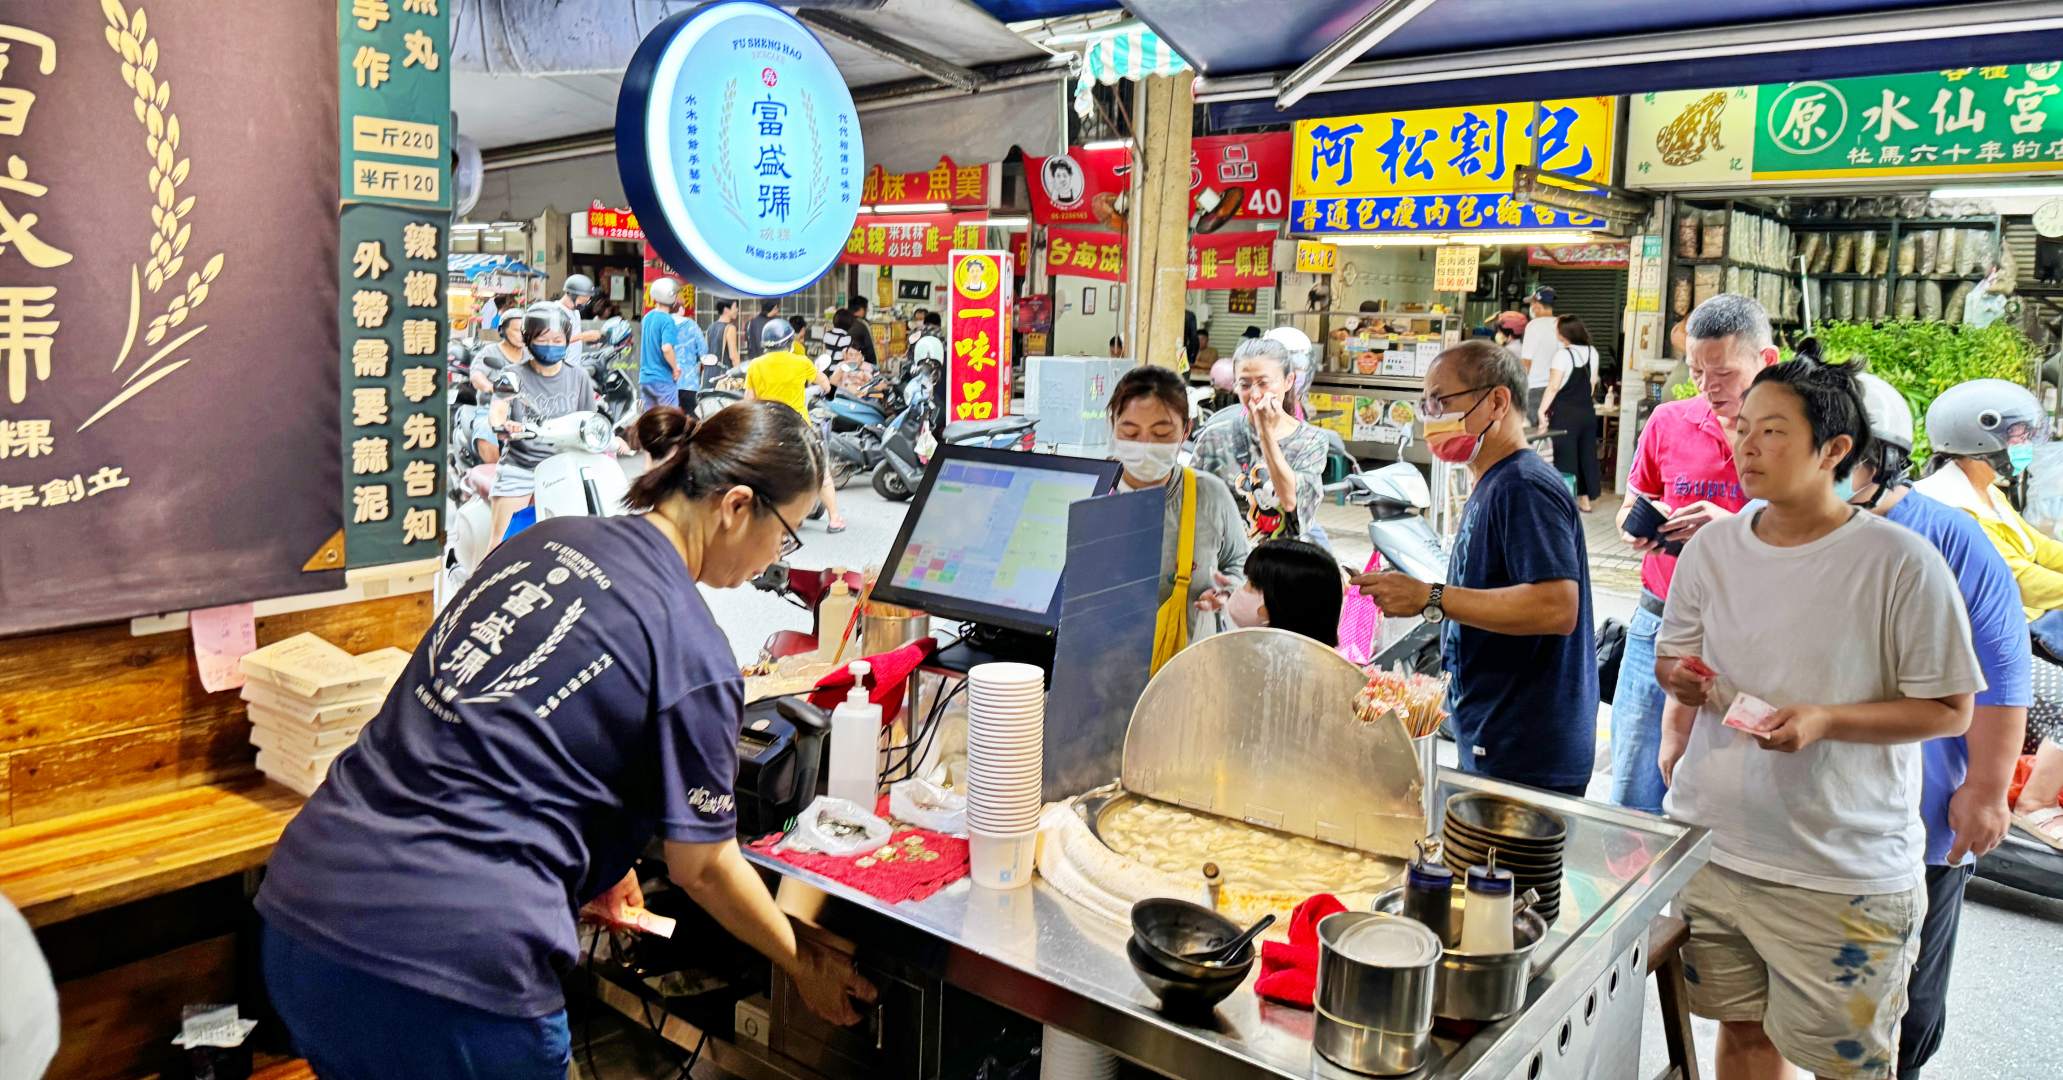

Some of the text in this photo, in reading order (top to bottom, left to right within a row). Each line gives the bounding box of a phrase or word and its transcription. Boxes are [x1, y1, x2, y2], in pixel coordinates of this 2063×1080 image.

[352, 0, 391, 89] 手作
[732, 38, 746, 50] FU
[747, 37, 781, 51] SHENG
[783, 44, 802, 60] HAO
[359, 127, 434, 151] 一斤220
[1309, 105, 1594, 187] 阿松割包
[1861, 80, 2062, 143] 水仙宮
[360, 168, 434, 193] 半斤120
[751, 94, 792, 223] 富盛號
[1248, 188, 1282, 215] 40
[352, 240, 391, 524] 外帶需要蒜泥
[402, 222, 439, 545] 辣椒請事先告知
[954, 308, 997, 420] 一味品
[544, 541, 563, 551] FU
[589, 567, 611, 590] HAO
[440, 580, 554, 687] 富盛號
